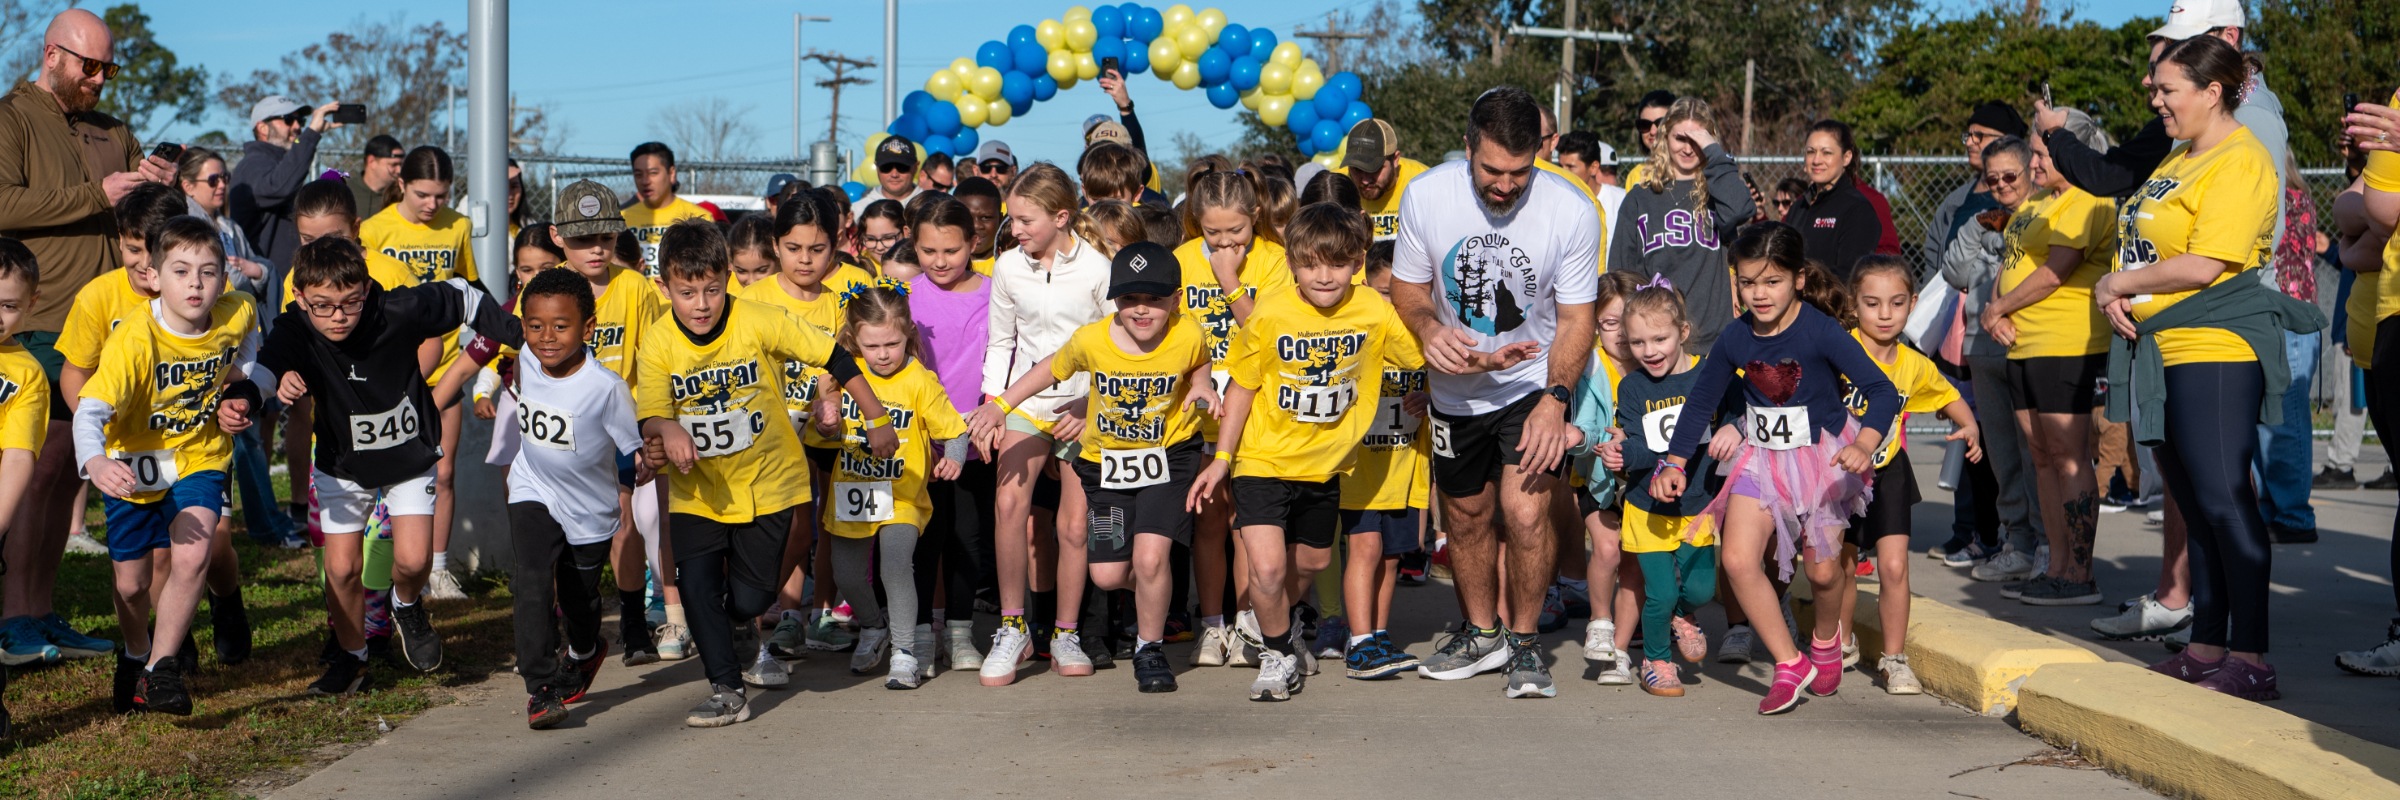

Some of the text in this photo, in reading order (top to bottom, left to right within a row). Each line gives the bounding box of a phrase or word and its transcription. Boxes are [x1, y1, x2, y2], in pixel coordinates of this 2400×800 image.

[1466, 233, 1510, 250] LOUP
[1637, 208, 1720, 257] LSU
[1277, 333, 1366, 362] Cougar
[670, 359, 759, 401] Cougar
[685, 357, 747, 376] Mulberry Elementary
[1110, 370, 1169, 378] Mulberry Elementary
[1095, 371, 1177, 398] Cougar
[356, 406, 417, 445] 346
[519, 402, 570, 445] 362
[691, 419, 735, 452] 55
[1756, 413, 1793, 444] 84
[1104, 453, 1163, 484] 250
[847, 487, 878, 516] 94
